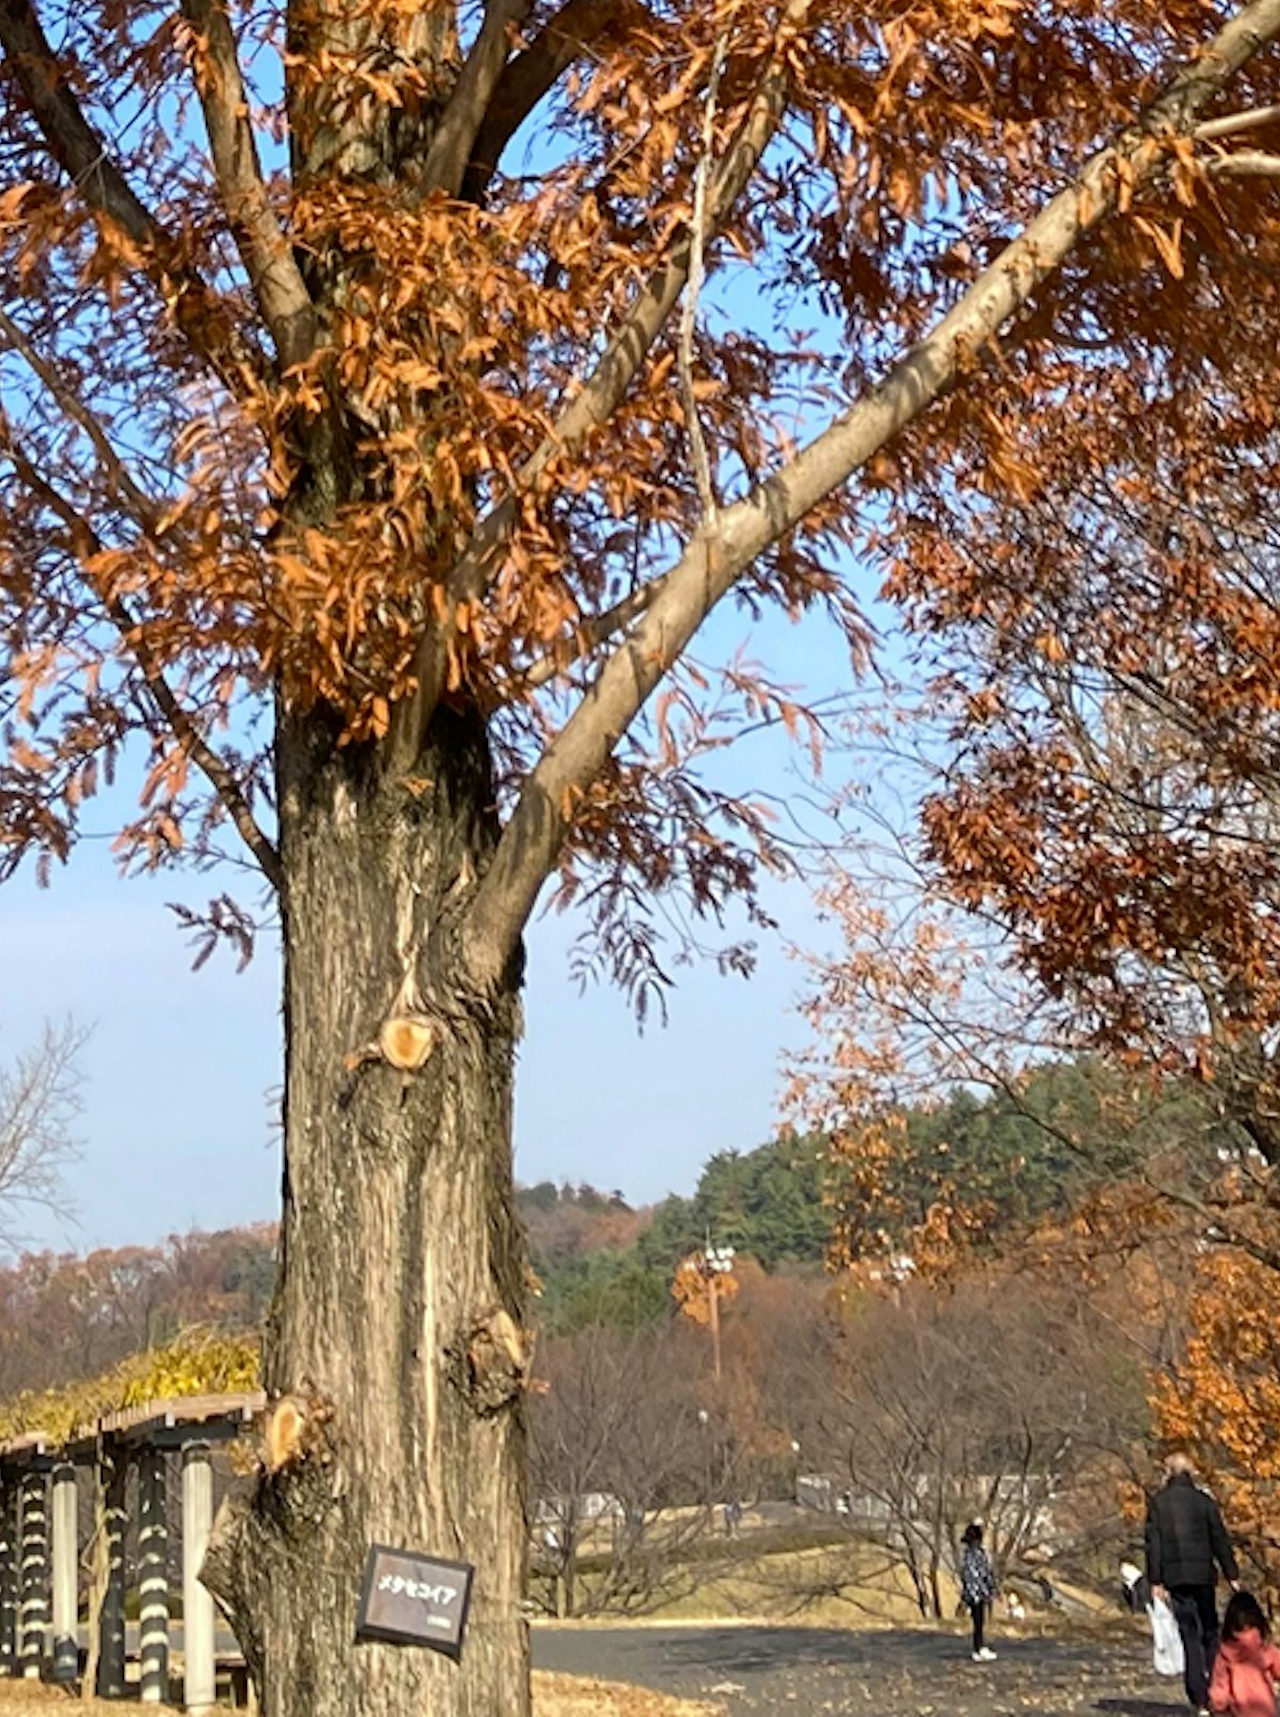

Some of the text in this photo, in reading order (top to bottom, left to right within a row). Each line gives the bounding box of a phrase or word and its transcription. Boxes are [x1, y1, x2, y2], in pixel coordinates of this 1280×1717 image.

[378, 1574, 457, 1605] メタセコイア
